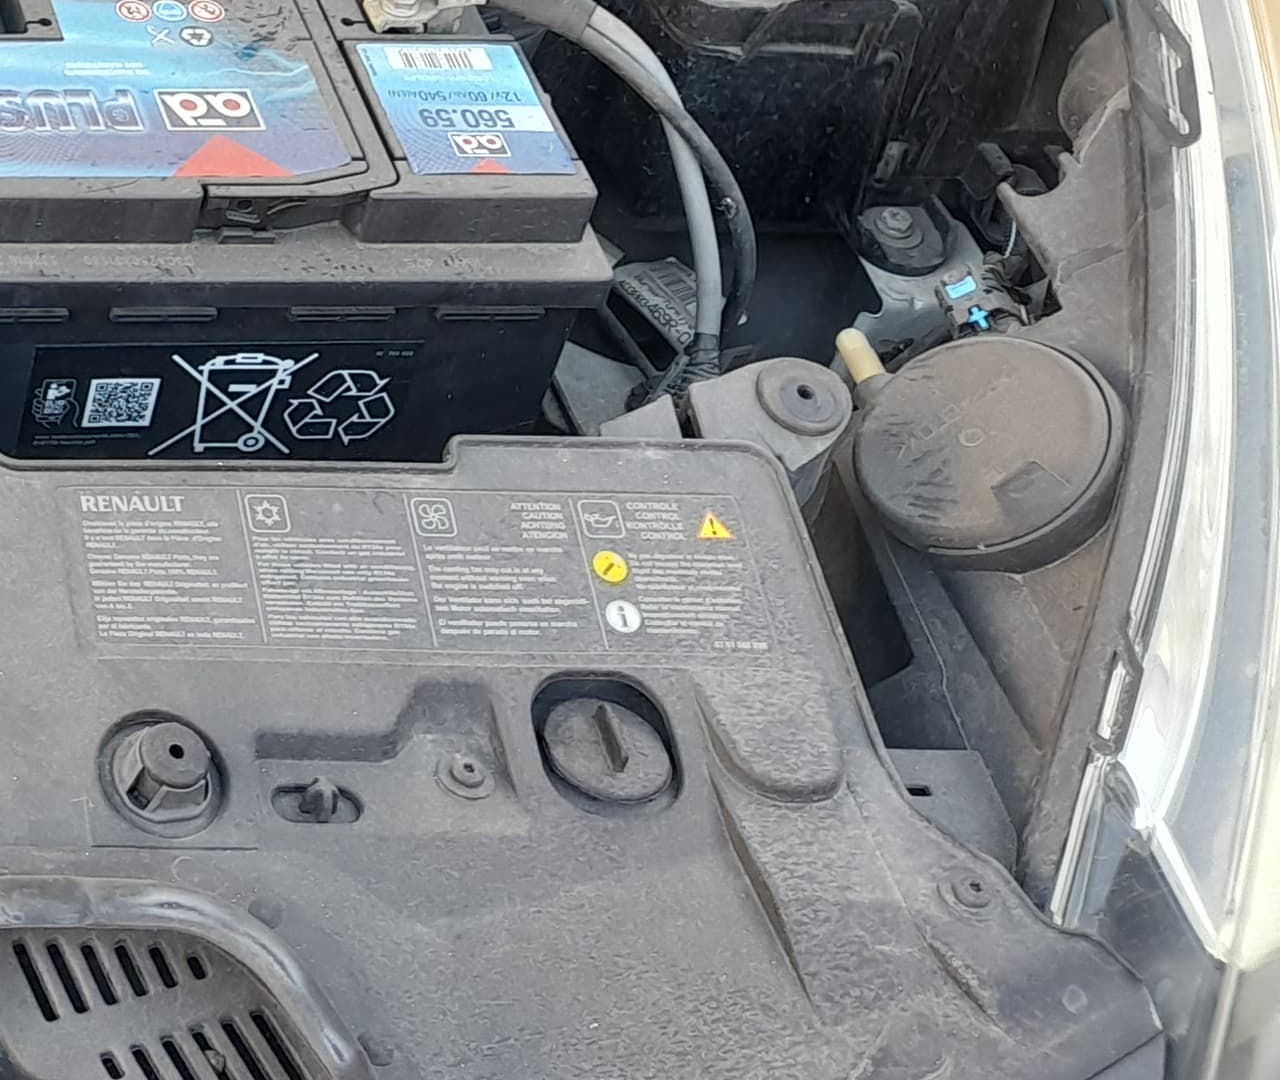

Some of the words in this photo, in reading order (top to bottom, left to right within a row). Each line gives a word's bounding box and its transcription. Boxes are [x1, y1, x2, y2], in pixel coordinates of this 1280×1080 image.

[419, 108, 515, 129] 560.59
[80, 495, 185, 512] RENAULT
[510, 502, 562, 511] ATTENTION
[521, 511, 563, 520] CAUTION
[635, 512, 680, 520] CONTROL
[520, 521, 566, 530] ACHTUNG
[640, 531, 687, 540] CONTROL
